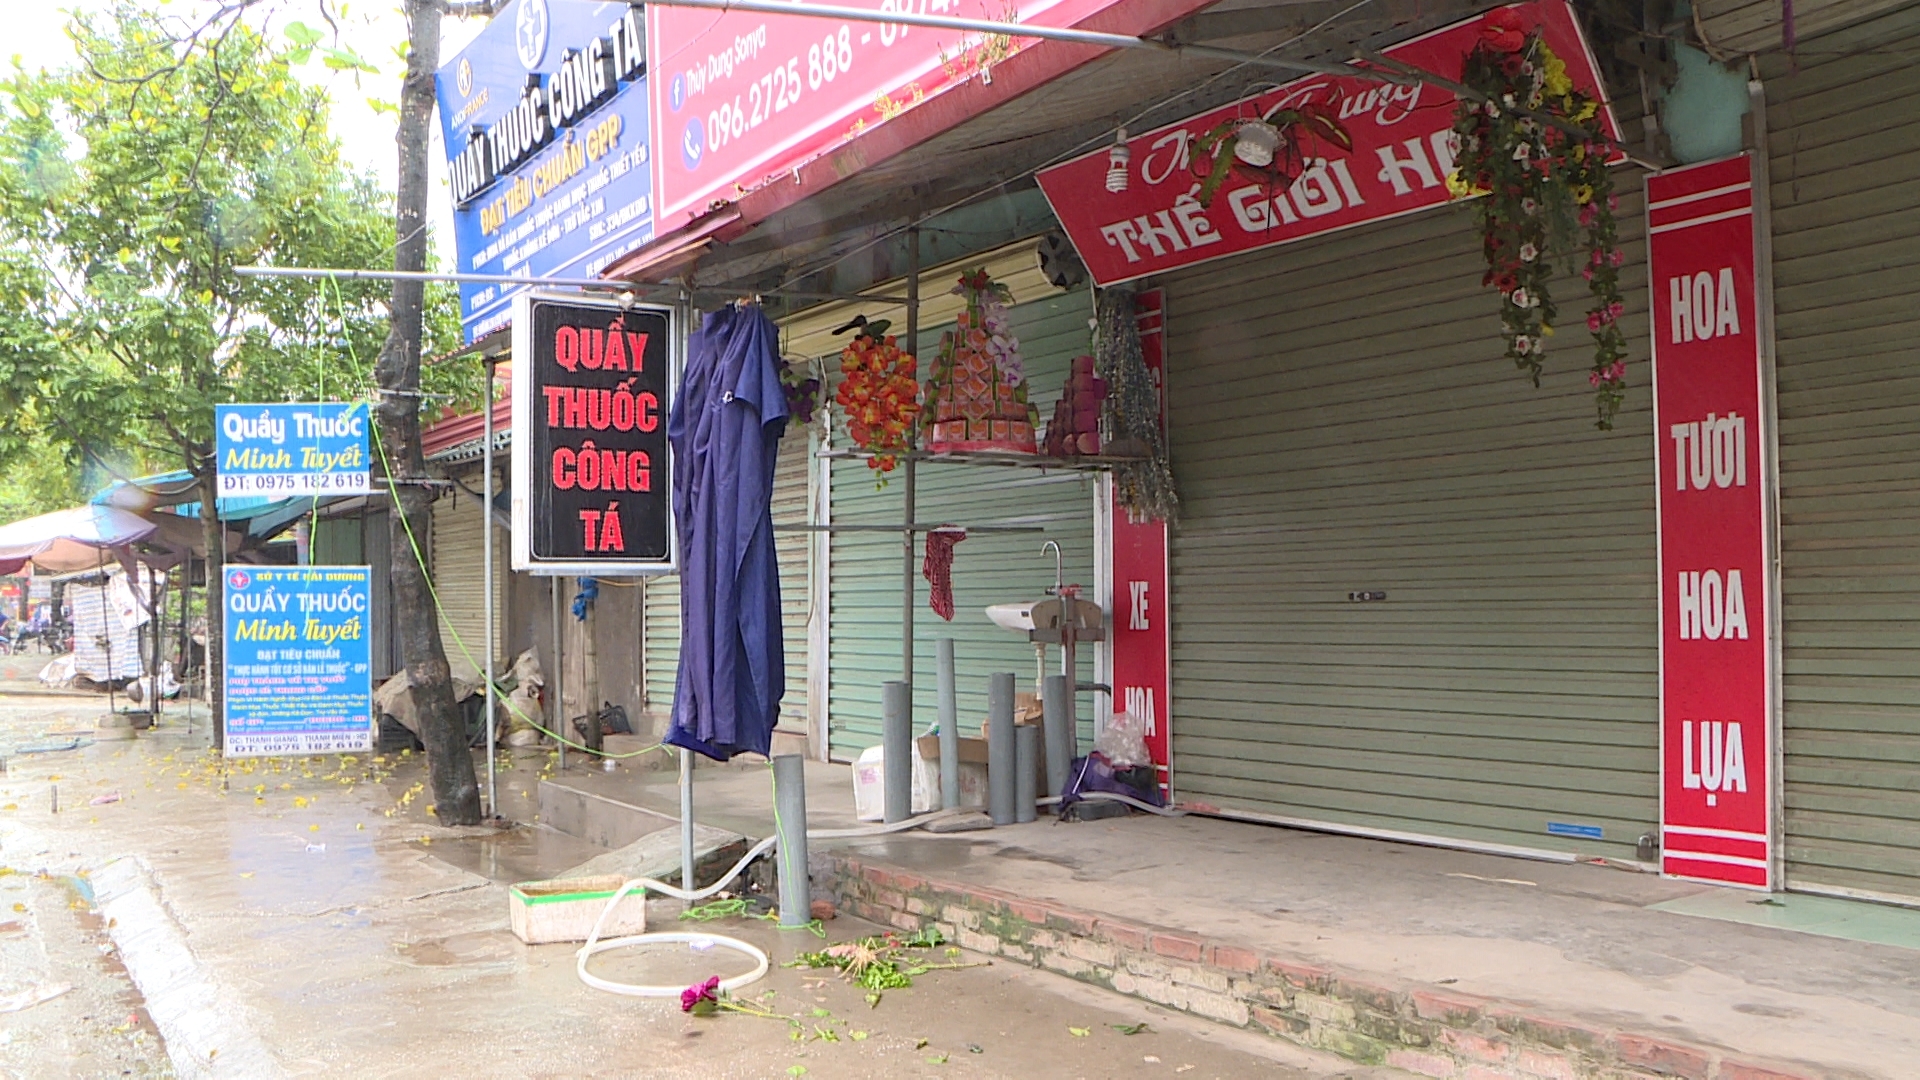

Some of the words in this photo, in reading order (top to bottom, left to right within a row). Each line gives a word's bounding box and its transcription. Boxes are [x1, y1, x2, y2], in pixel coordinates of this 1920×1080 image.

[708, 47, 733, 83] Dung
[734, 24, 766, 65] Sonya
[488, 73, 544, 175] THUỐC
[548, 37, 606, 129] CÔNG
[708, 56, 801, 152] 096.2725
[808, 24, 852, 91] 888
[480, 196, 506, 236] ĐẠT
[505, 176, 532, 218] TIÊU
[532, 127, 586, 198] CHUẨN
[586, 113, 621, 162] GPP
[1100, 183, 1222, 263] THẾ
[1669, 267, 1741, 344] HOA
[555, 315, 649, 372] QUẦY
[543, 377, 658, 432] THUỐC
[225, 447, 292, 470] Minh
[300, 443, 362, 473] Tuyết
[552, 440, 651, 492] CÔNG
[1671, 412, 1746, 490] TƯƠI
[224, 476, 250, 490] ĐT:
[256, 475, 295, 490] 0975
[302, 475, 330, 488] 182
[335, 473, 364, 488] 619
[579, 501, 624, 551] TÁ
[230, 585, 290, 613] QUẦY
[296, 584, 366, 613] THUỐC
[1128, 581, 1149, 630] XE
[1678, 569, 1749, 640] HOA
[234, 618, 298, 642] Minh
[305, 615, 362, 646] Tuyết
[1682, 720, 1748, 806] LỤA
